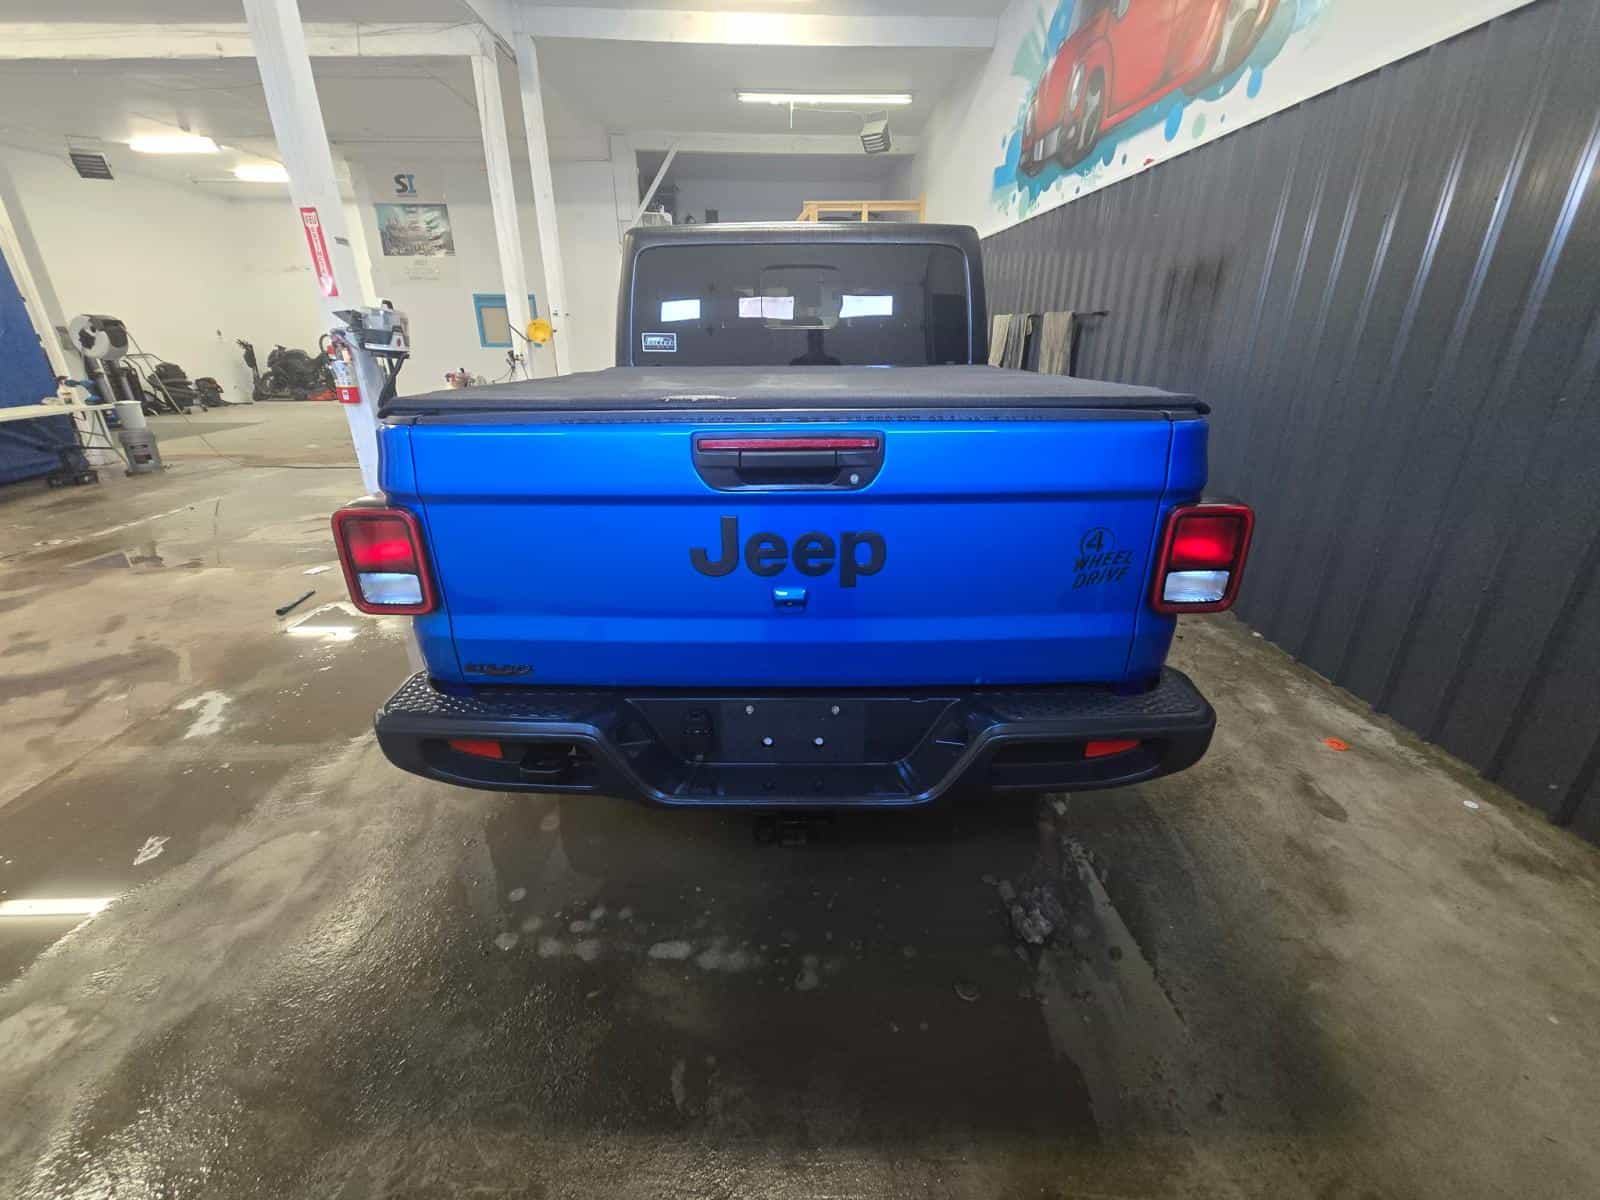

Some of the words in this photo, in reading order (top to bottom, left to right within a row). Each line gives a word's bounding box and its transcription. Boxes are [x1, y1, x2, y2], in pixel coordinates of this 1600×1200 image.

[689, 515, 886, 588] Jeep
[1073, 551, 1134, 573] WHEEL
[1072, 567, 1128, 591] DRIVE
